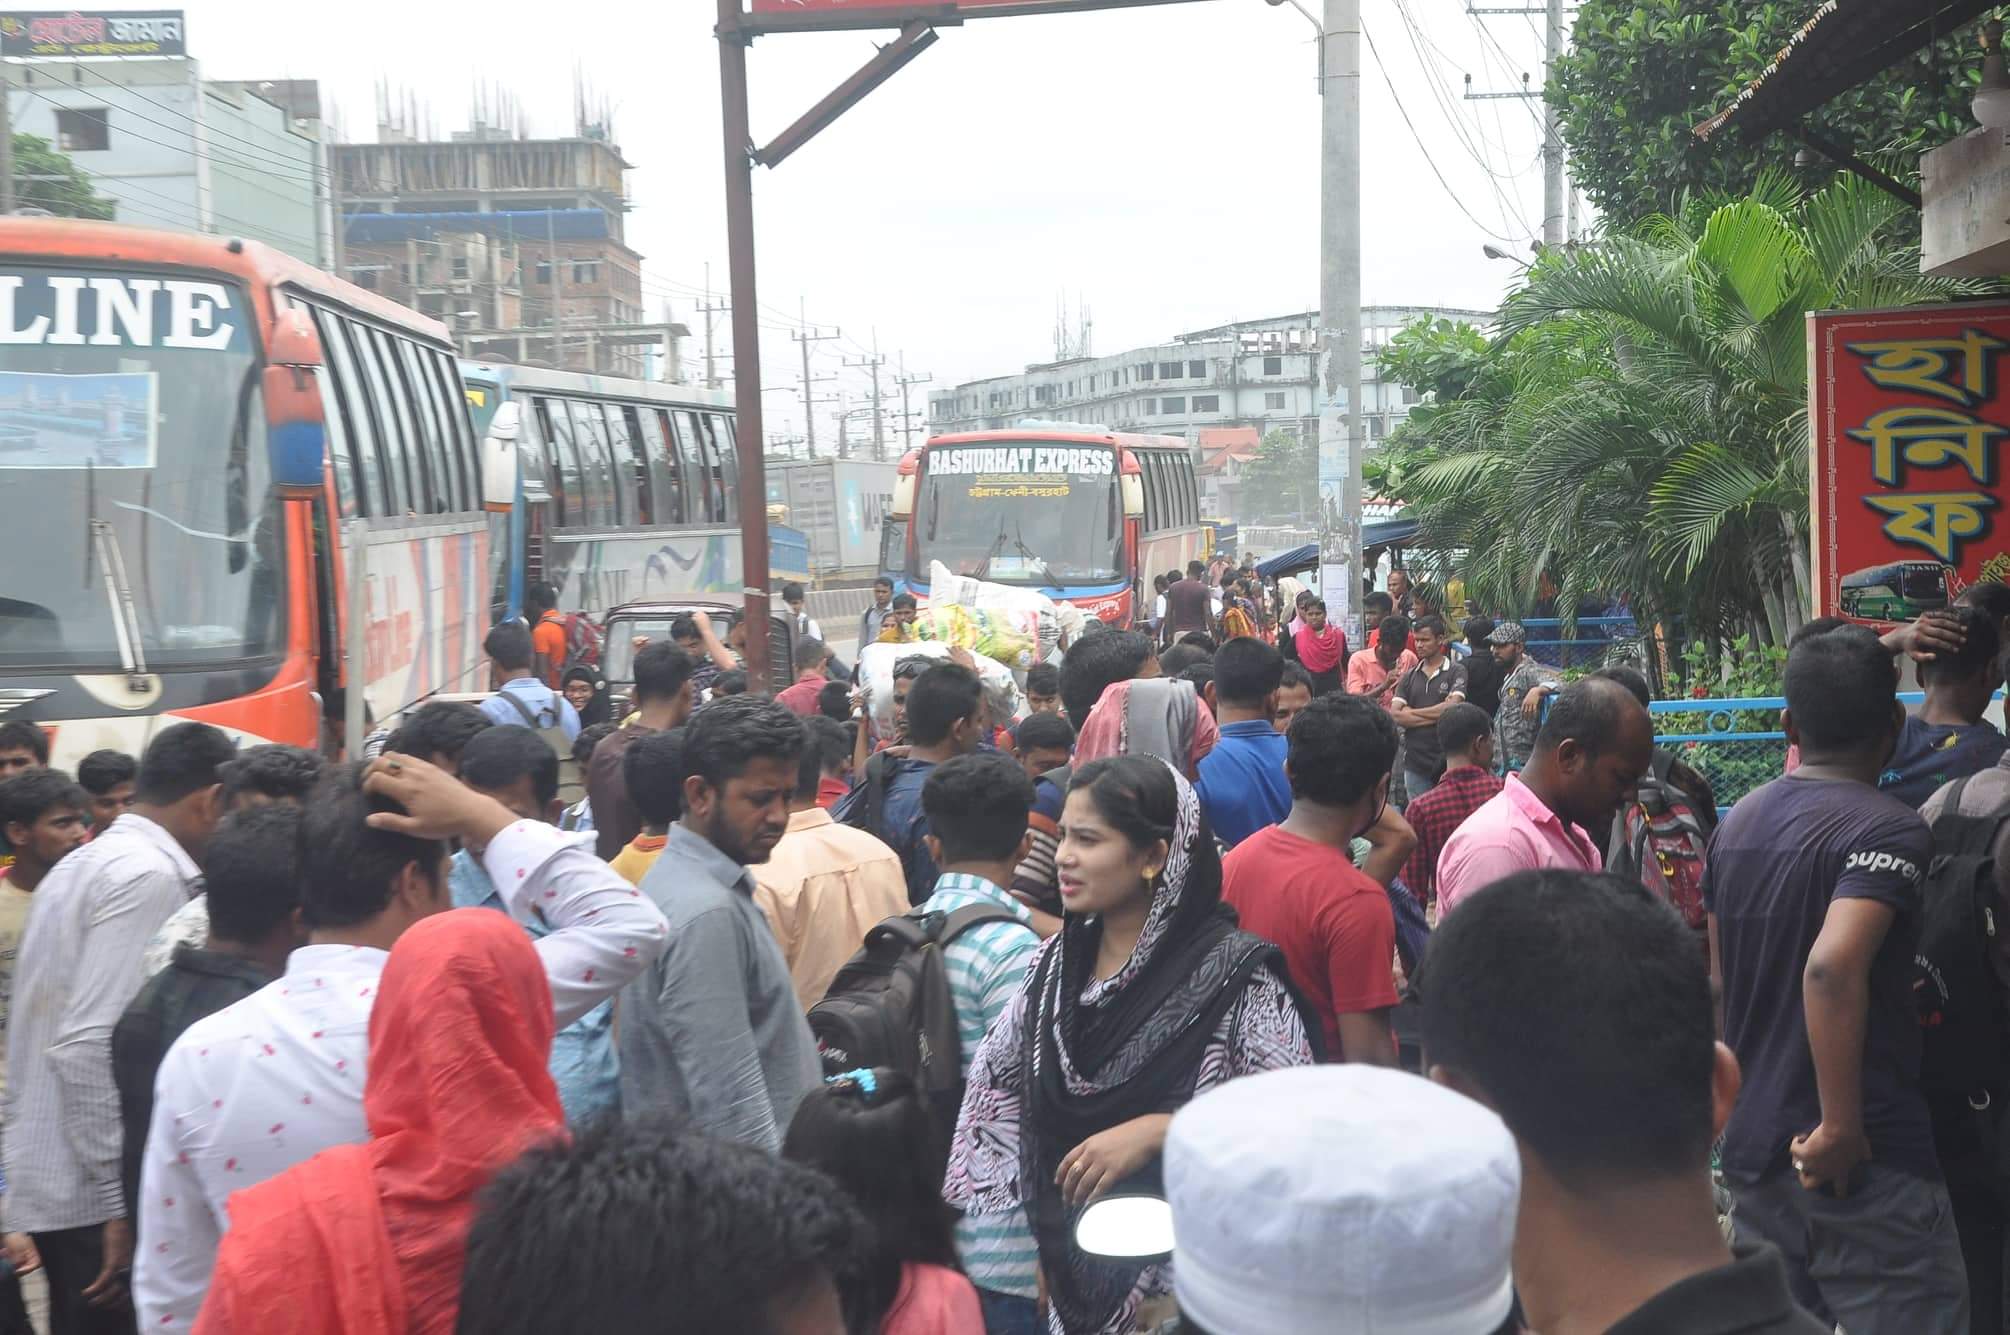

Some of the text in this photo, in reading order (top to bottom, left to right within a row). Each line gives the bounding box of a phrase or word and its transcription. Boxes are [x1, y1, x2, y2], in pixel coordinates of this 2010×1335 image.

[0, 276, 235, 351] LINE
[928, 448, 1113, 475] BASHURHAT EXPRESS
